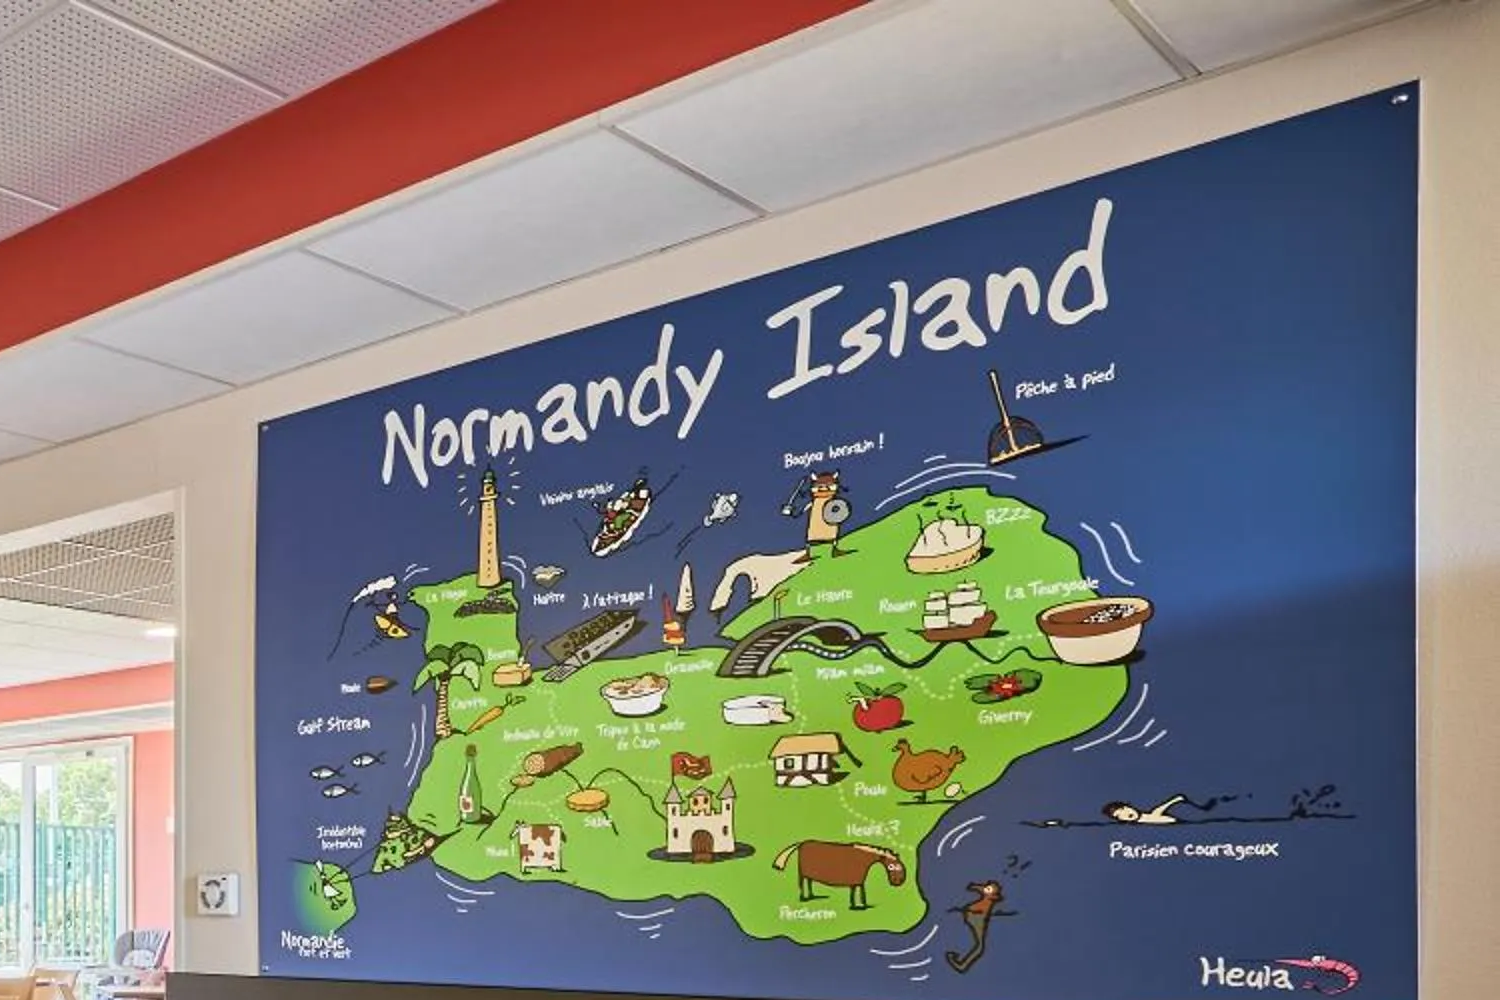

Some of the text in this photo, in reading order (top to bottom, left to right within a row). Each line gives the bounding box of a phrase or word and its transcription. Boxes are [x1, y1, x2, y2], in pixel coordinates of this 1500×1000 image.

[381, 197, 1113, 488] Normandy Island
[797, 593, 811, 606] Le
[1005, 585, 1026, 601] La
[1109, 841, 1279, 861] Parisien courageux
[1199, 956, 1295, 990] Heula
